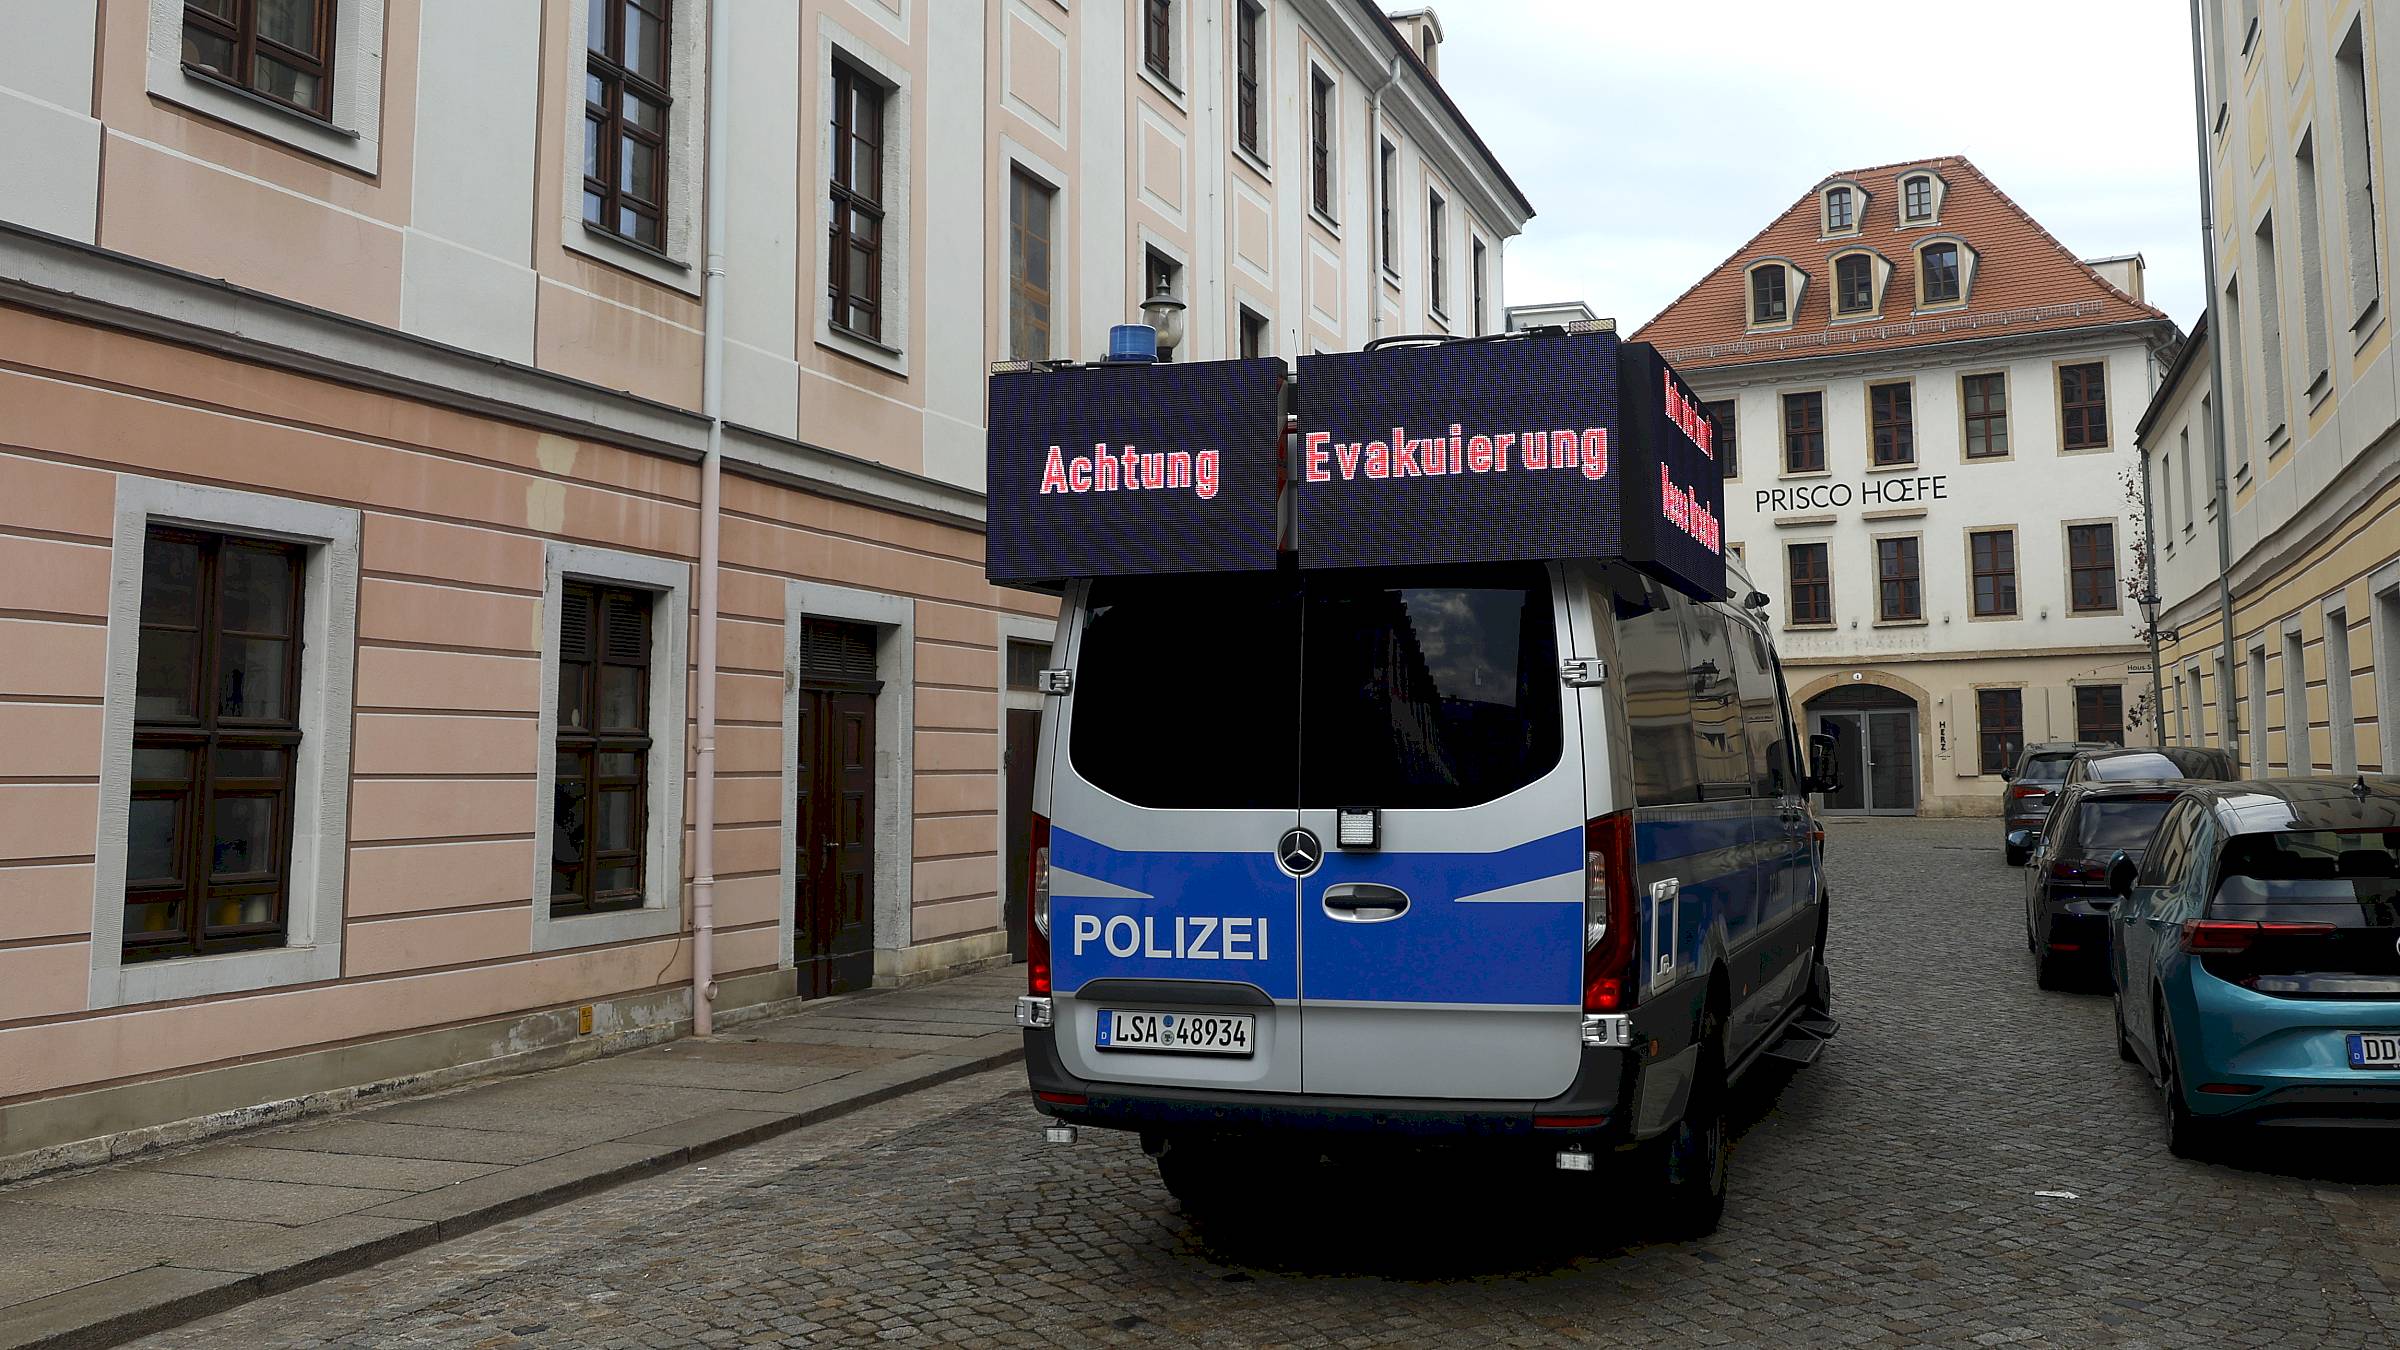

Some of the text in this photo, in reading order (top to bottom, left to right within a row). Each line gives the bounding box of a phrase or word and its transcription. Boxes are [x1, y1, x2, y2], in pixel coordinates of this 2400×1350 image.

[1305, 424, 1608, 482] Evakuierung
[1040, 444, 1220, 500] Achtung
[1756, 484, 1852, 513] PRISCO
[1939, 721, 1947, 751] HERZ
[1074, 914, 1268, 960] POLIZEI
[1101, 1031, 1107, 1040] D
[1116, 1015, 1246, 1047] LSA 48934
[2354, 1052, 2360, 1060] D
[2364, 1039, 2396, 1060] DD
